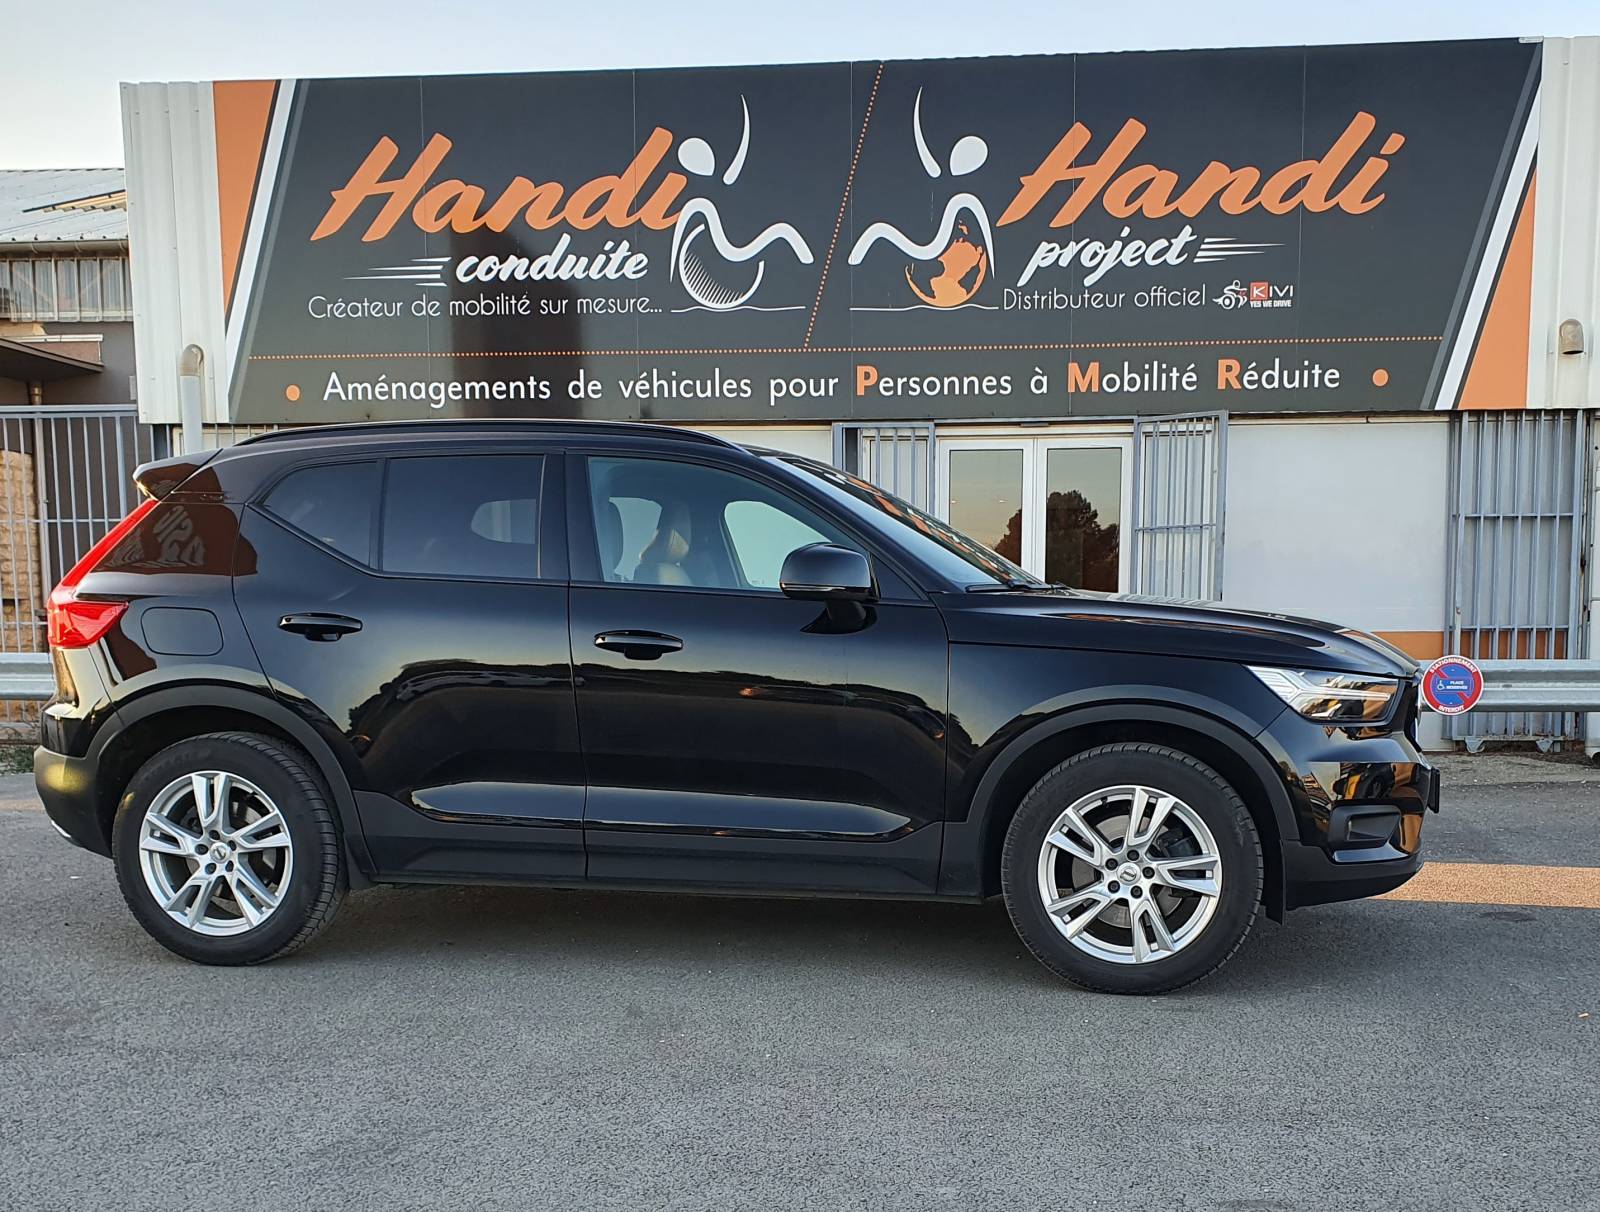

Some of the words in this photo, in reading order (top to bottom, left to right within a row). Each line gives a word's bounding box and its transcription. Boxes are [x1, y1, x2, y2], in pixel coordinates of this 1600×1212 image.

[310, 126, 687, 242] Handi
[996, 111, 1406, 228] Handi
[455, 232, 649, 284] conduite
[1017, 225, 1197, 287] project
[308, 295, 404, 319] Créateur
[411, 293, 441, 318] de
[449, 294, 531, 316] mobilité
[540, 299, 569, 315] sur
[1003, 287, 1126, 310] Distributeur
[1134, 284, 1206, 308] officiel
[1251, 283, 1294, 300] KIVI
[323, 372, 551, 409] Aménagements
[568, 368, 603, 399] de
[618, 368, 752, 399] véhicules
[769, 376, 839, 405] pour
[856, 364, 1012, 396] Personnes
[1030, 366, 1048, 394] à
[1066, 361, 1198, 393] Mobilité
[1217, 358, 1341, 390] Réduite
[1429, 657, 1477, 673] STATIONNEMENT
[1439, 704, 1465, 713] INTERDIT
